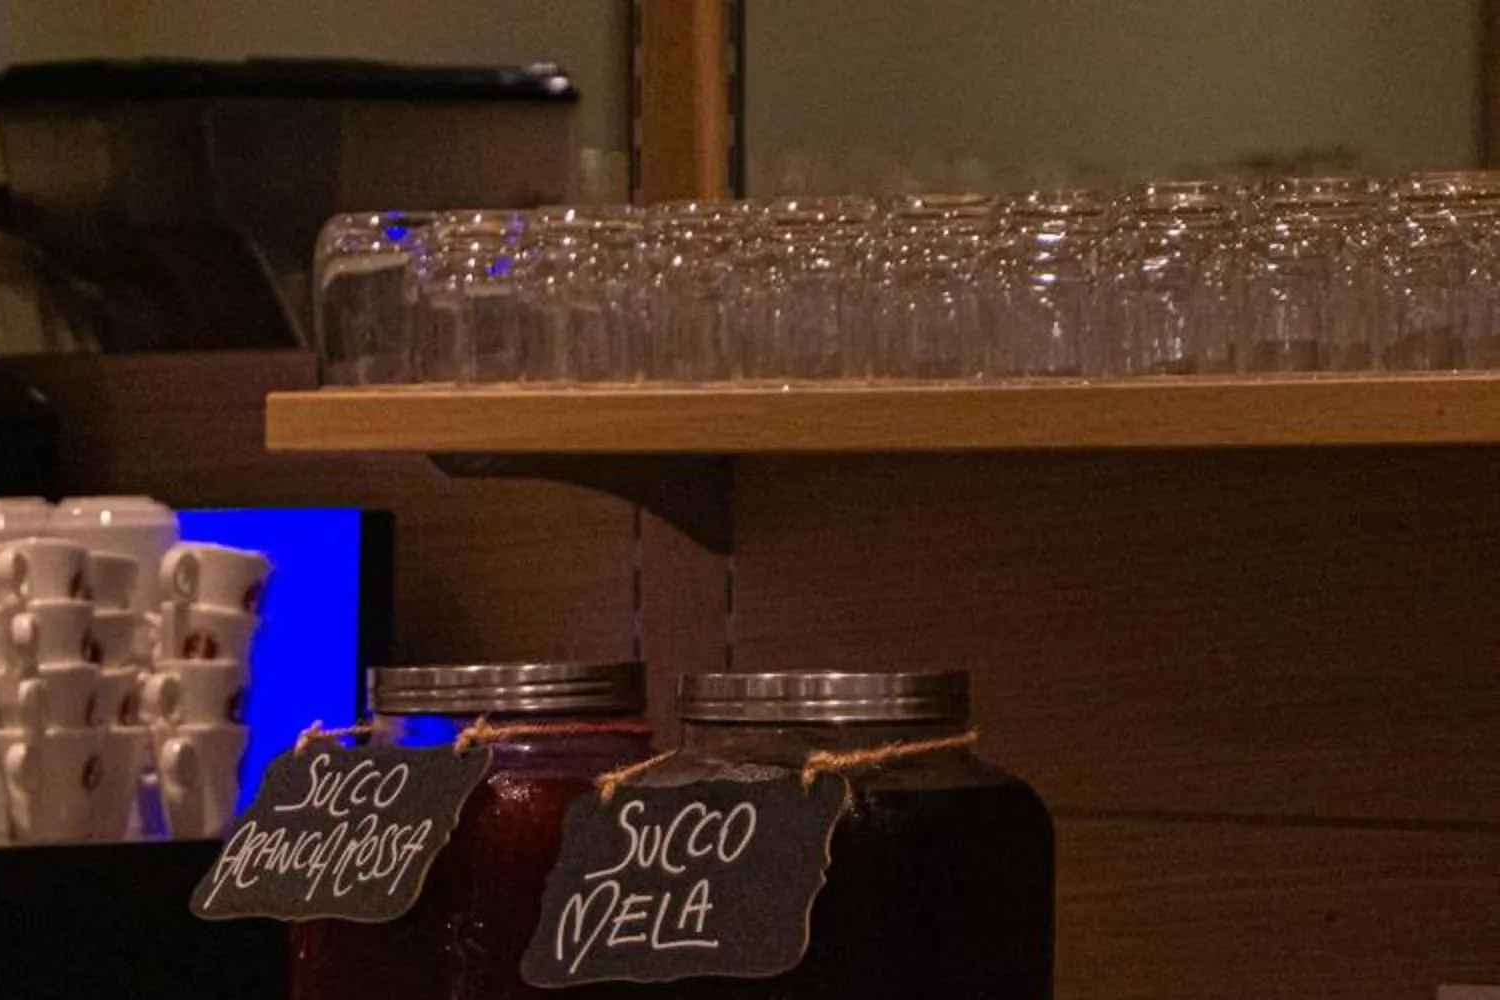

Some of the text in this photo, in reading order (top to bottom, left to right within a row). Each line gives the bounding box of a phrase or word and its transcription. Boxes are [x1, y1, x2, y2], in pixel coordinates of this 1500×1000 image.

[274, 753, 408, 815] SUCCO
[584, 800, 756, 879] SUCCO
[556, 880, 719, 975] MELA
